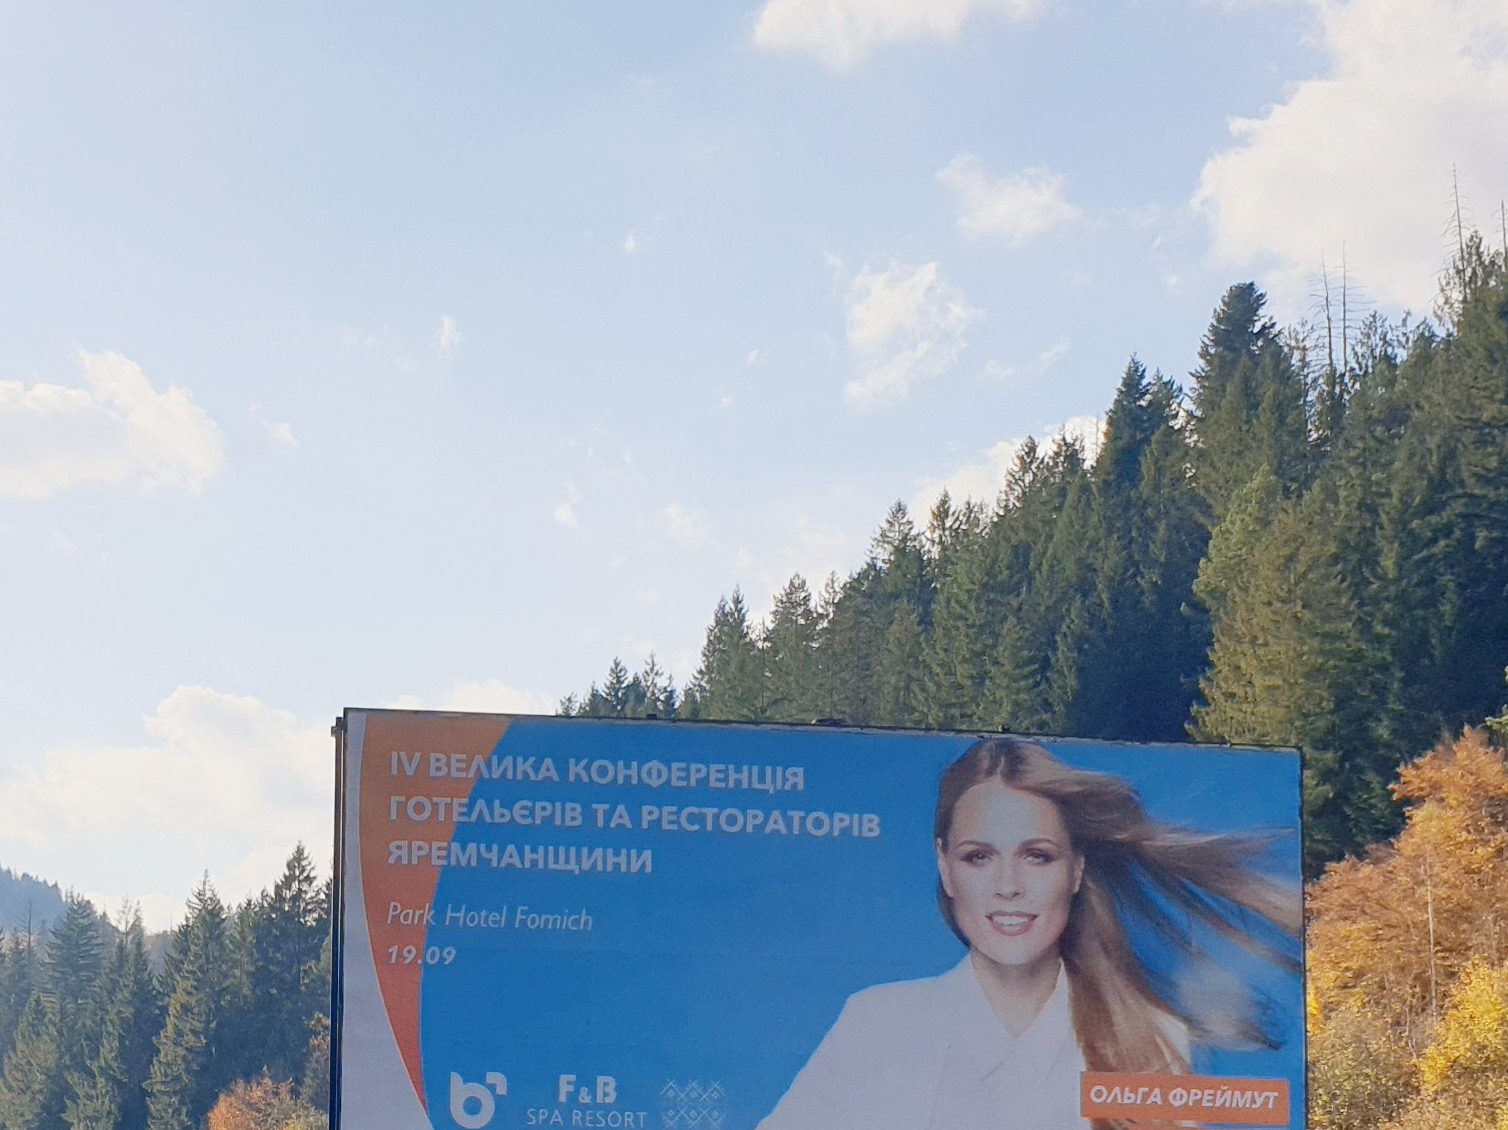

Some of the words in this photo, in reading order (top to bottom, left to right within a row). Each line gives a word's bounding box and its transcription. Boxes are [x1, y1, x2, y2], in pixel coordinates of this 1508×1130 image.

[390, 750, 422, 777] IV
[429, 752, 560, 783] ВЕЛИКА
[568, 757, 805, 795] КОНФЕРЕНЦІЯ
[389, 795, 584, 828] ГОТЕЛЬЄРІВ
[591, 803, 633, 830] ТА
[641, 805, 882, 839] РЕСТОРАТОРІВ
[387, 839, 653, 876] ЯРЕМЧАНЩИНИ
[386, 901, 436, 926] Park
[445, 903, 508, 929] Hotel
[514, 905, 593, 932] Fomich
[387, 944, 457, 966] 19.09
[558, 1074, 618, 1105] F&B
[1090, 1084, 1163, 1106] ОЛЬГА
[1168, 1085, 1280, 1109] ФРЕЙМУТ
[526, 1108, 565, 1127] SPA
[571, 1109, 648, 1129] RESORT
